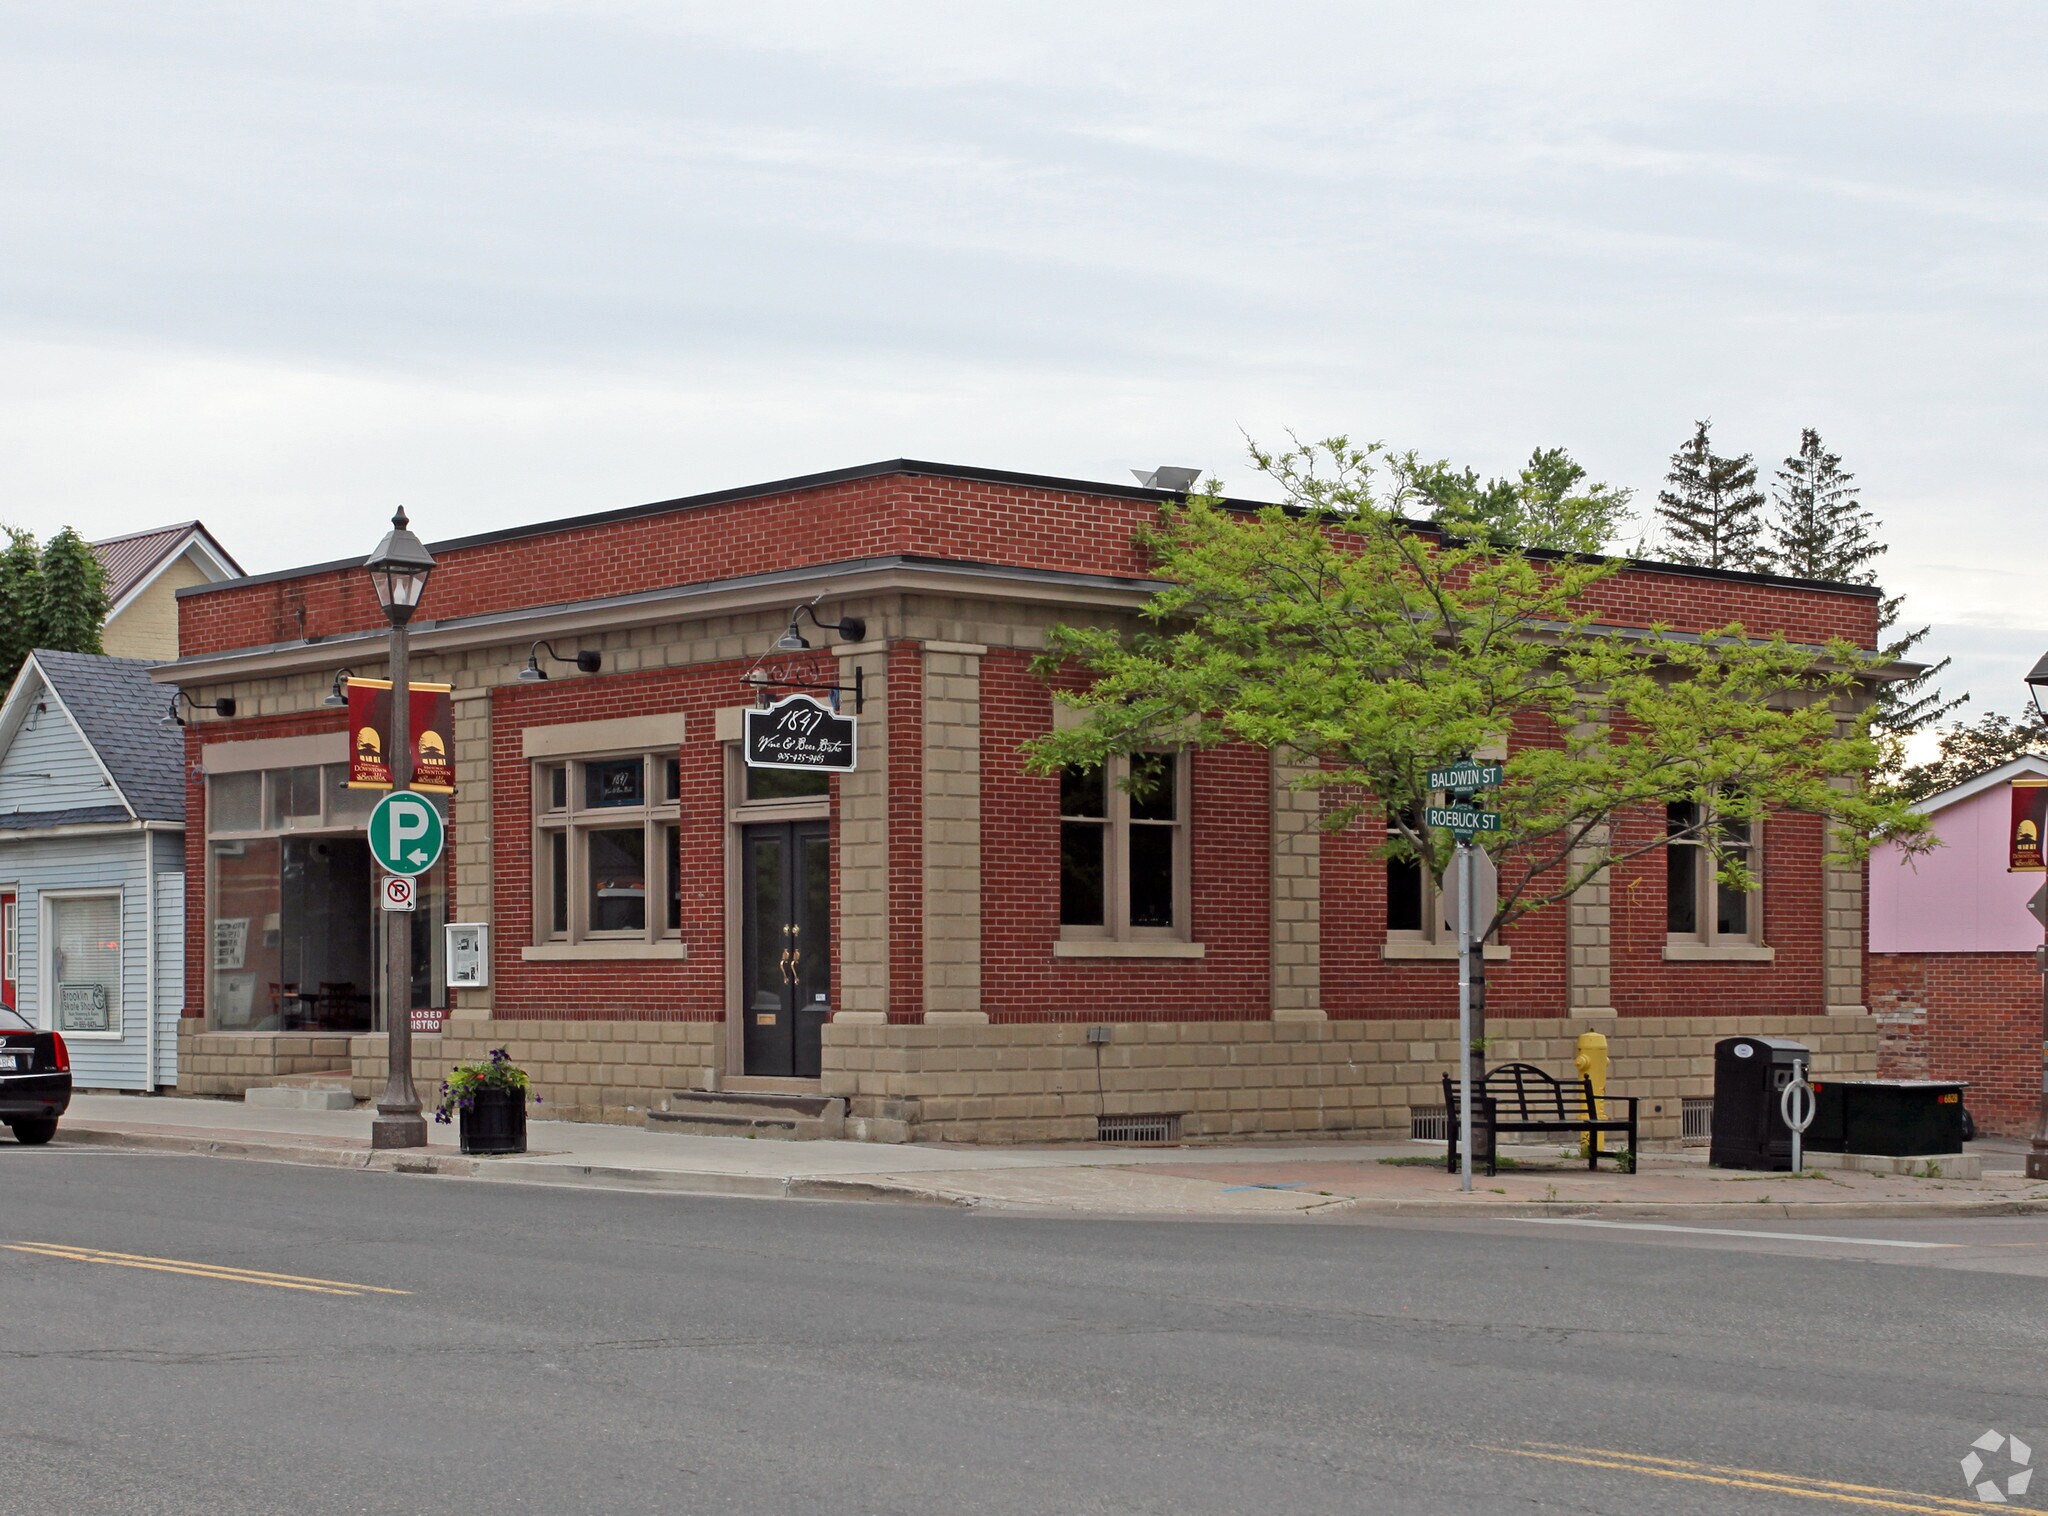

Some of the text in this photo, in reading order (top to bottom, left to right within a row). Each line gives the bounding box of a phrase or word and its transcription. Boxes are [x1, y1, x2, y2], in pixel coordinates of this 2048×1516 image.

[776, 708, 823, 736] 1847
[757, 734, 852, 753] Wine & Beer Bistro
[417, 767, 452, 776] DOWNTOWN
[1431, 767, 1497, 788] BALDWIN ST
[1431, 810, 1496, 830] ROEBUCK ST
[389, 801, 429, 861] P
[63, 990, 89, 1001] Brooklin
[64, 1002, 80, 1011] Skate
[411, 1011, 443, 1019] LOSED
[411, 1020, 440, 1030] ISTRO
